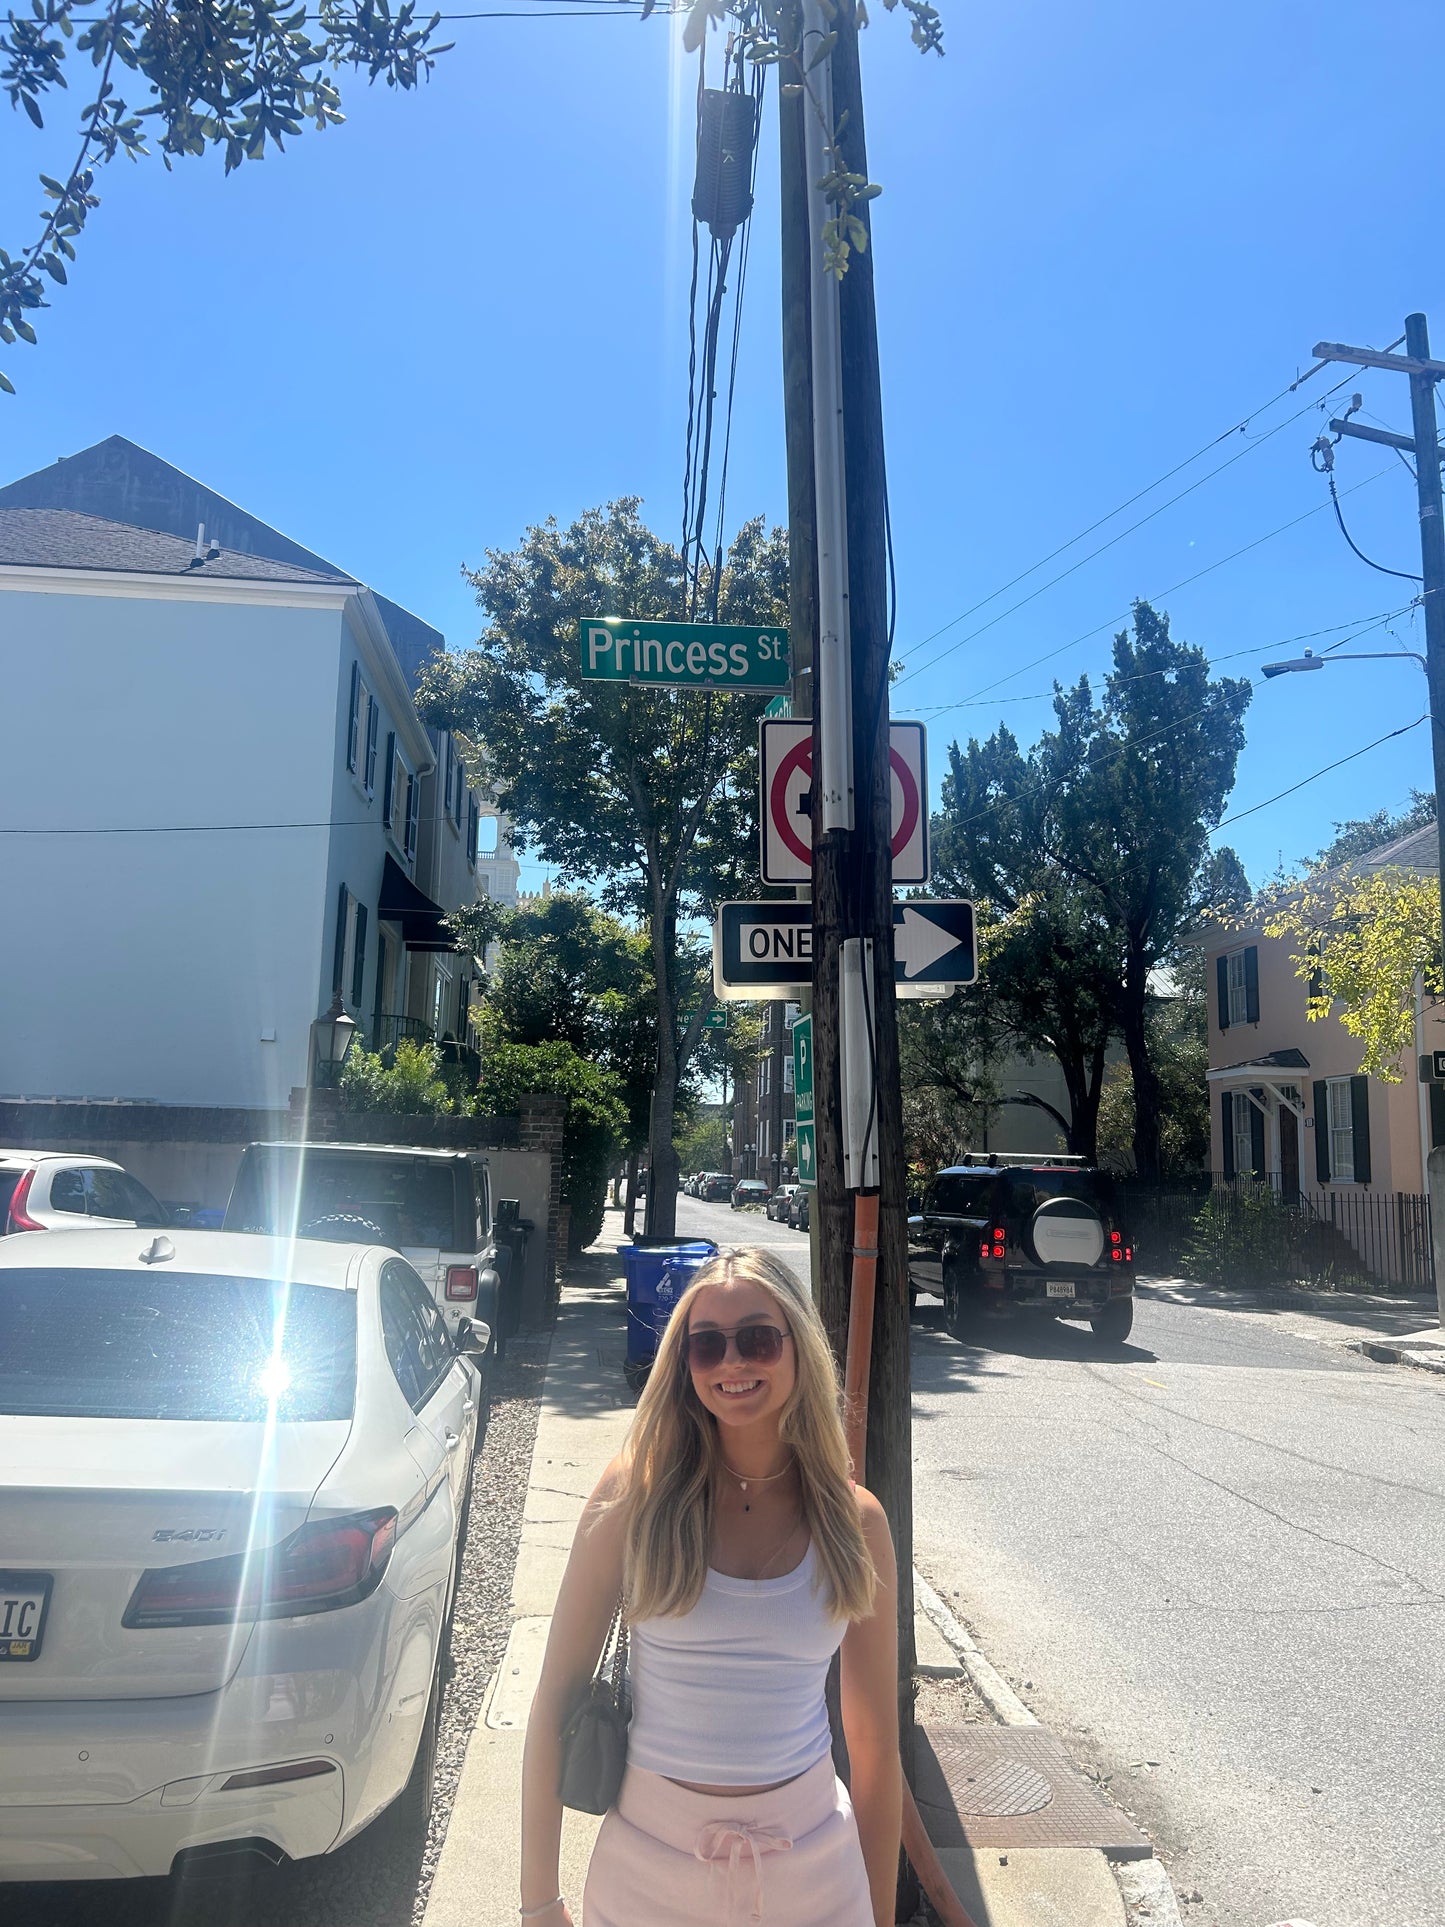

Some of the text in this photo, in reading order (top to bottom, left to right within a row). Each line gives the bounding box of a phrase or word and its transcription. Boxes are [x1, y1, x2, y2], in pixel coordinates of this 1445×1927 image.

[588, 627, 782, 677] Princess St
[749, 927, 812, 959] ONE
[800, 1039, 807, 1081] P
